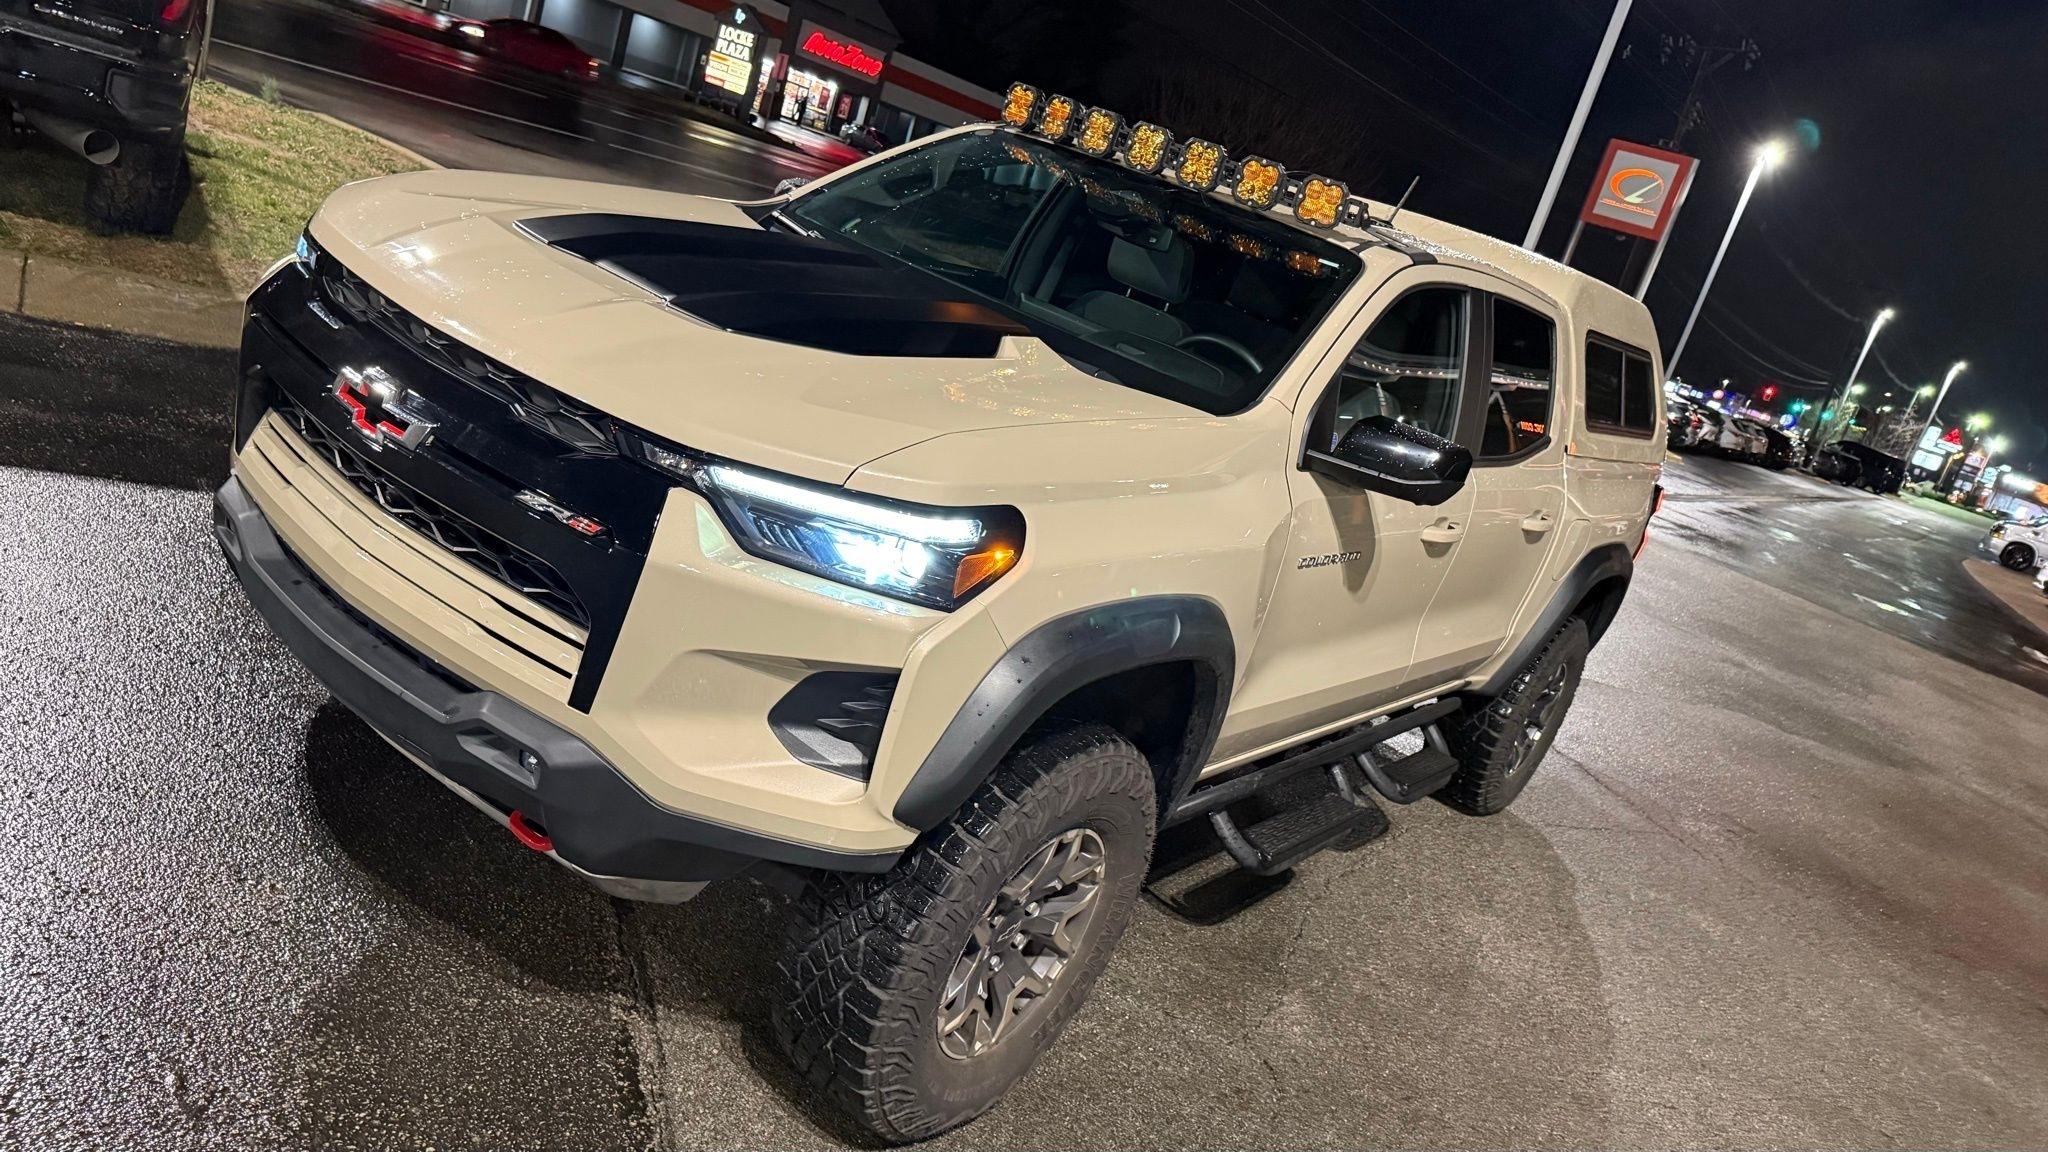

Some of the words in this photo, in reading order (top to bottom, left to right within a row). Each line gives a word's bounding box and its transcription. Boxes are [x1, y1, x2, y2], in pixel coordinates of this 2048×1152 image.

[720, 24, 754, 47] LOCKE
[716, 39, 750, 60] PLAZA
[802, 32, 882, 76] AutoZone
